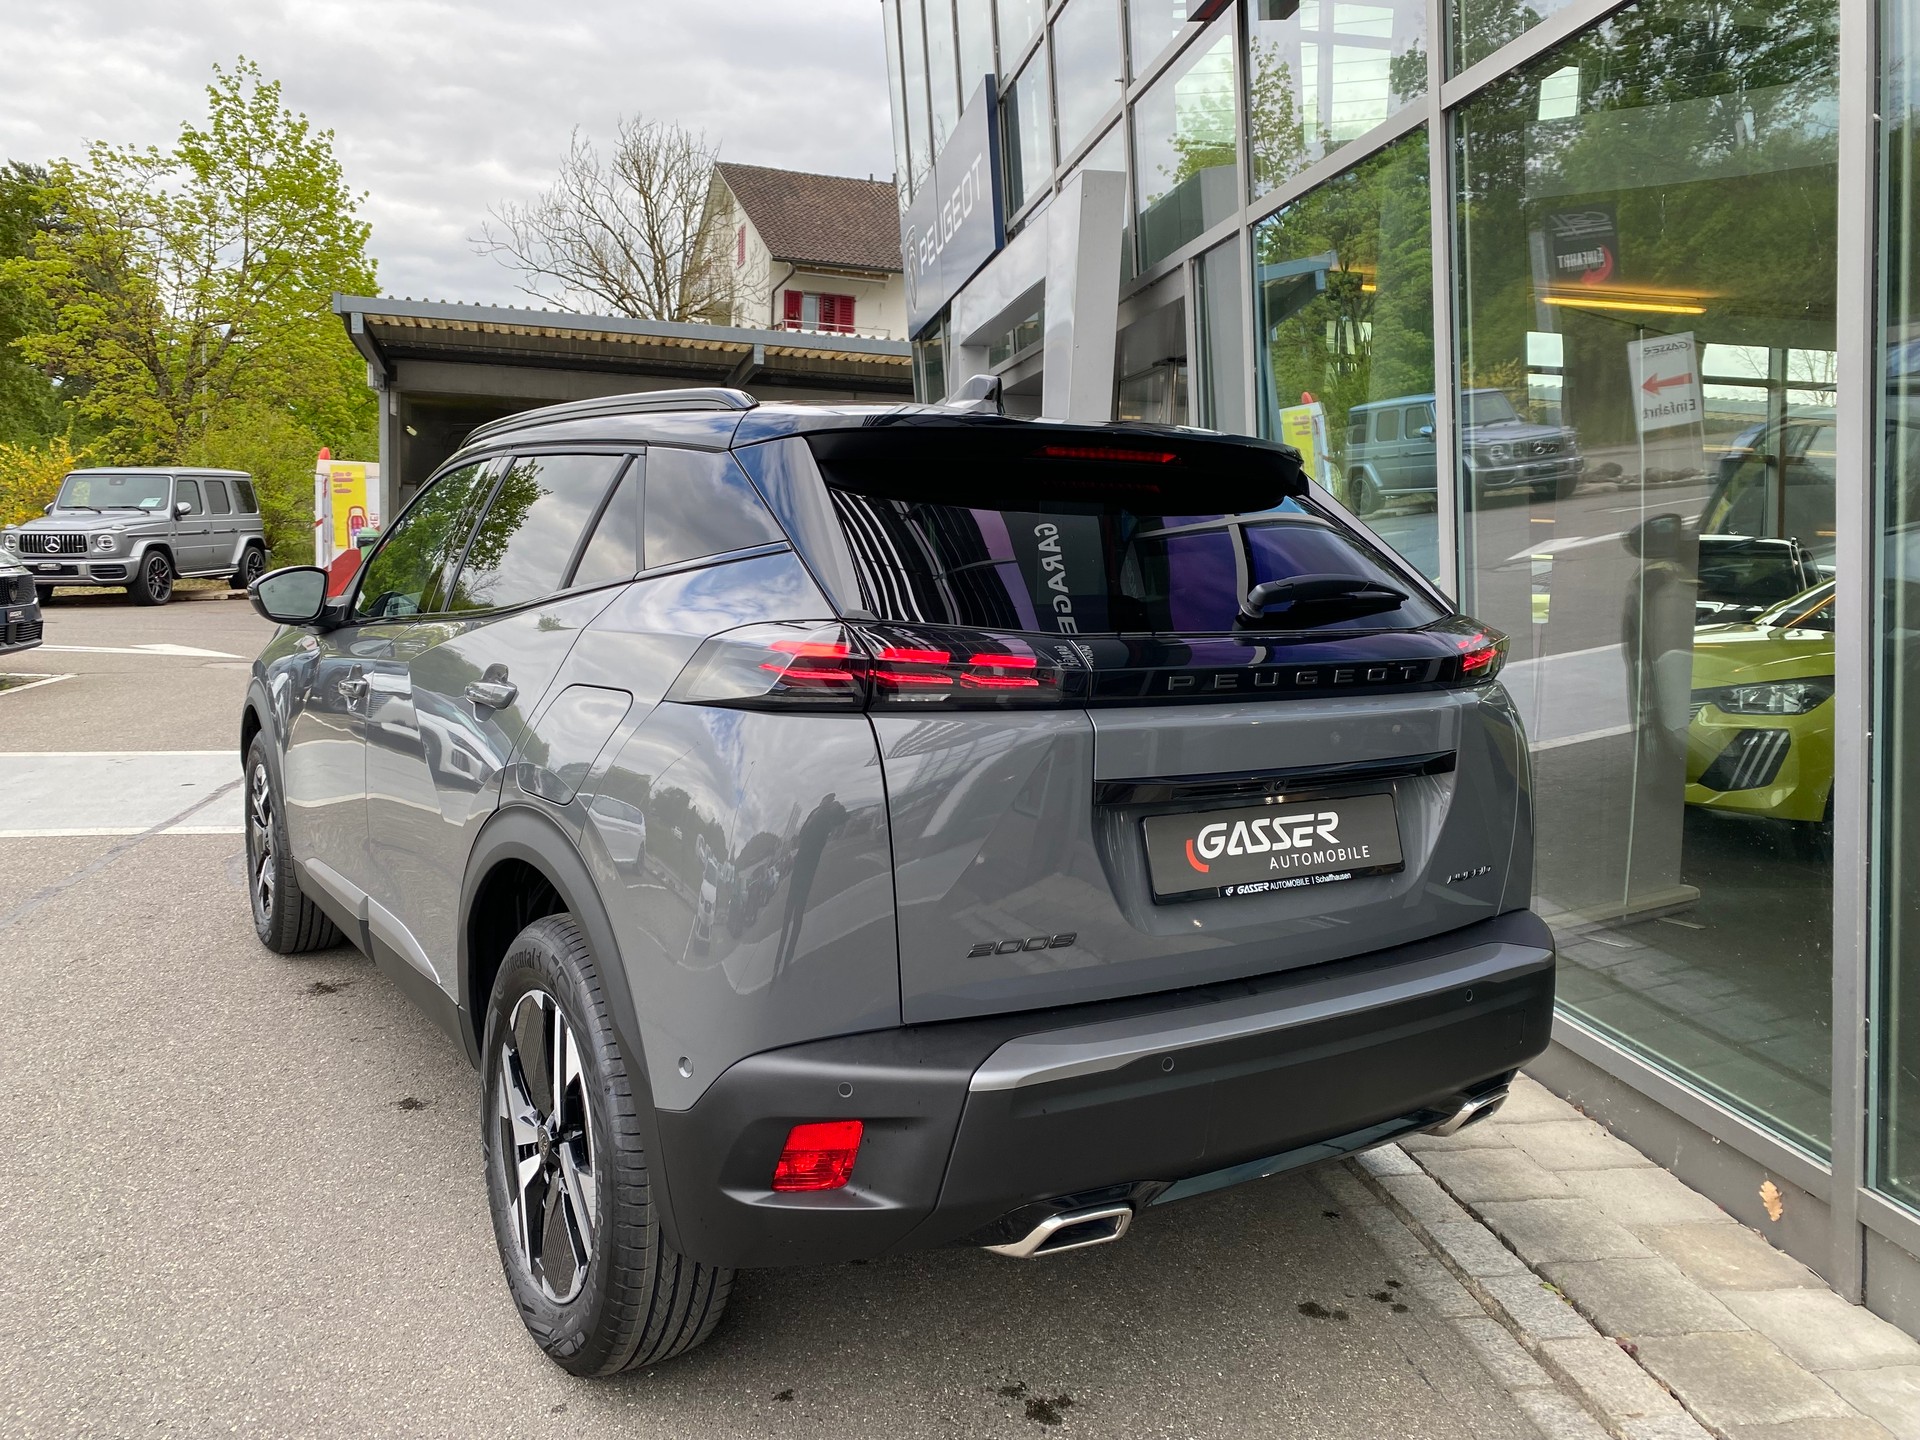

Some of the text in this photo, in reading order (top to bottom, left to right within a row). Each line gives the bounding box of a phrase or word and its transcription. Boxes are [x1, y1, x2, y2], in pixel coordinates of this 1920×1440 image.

[919, 152, 983, 276] PEUGEOT
[1167, 665, 1418, 691] PEUGEOT
[1196, 810, 1340, 860] GASSER
[1269, 844, 1371, 870] AUTOMOBILE
[1236, 872, 1352, 895] GASSER AUTOMOBILE Schaffhausen
[966, 931, 1078, 958] 2008
